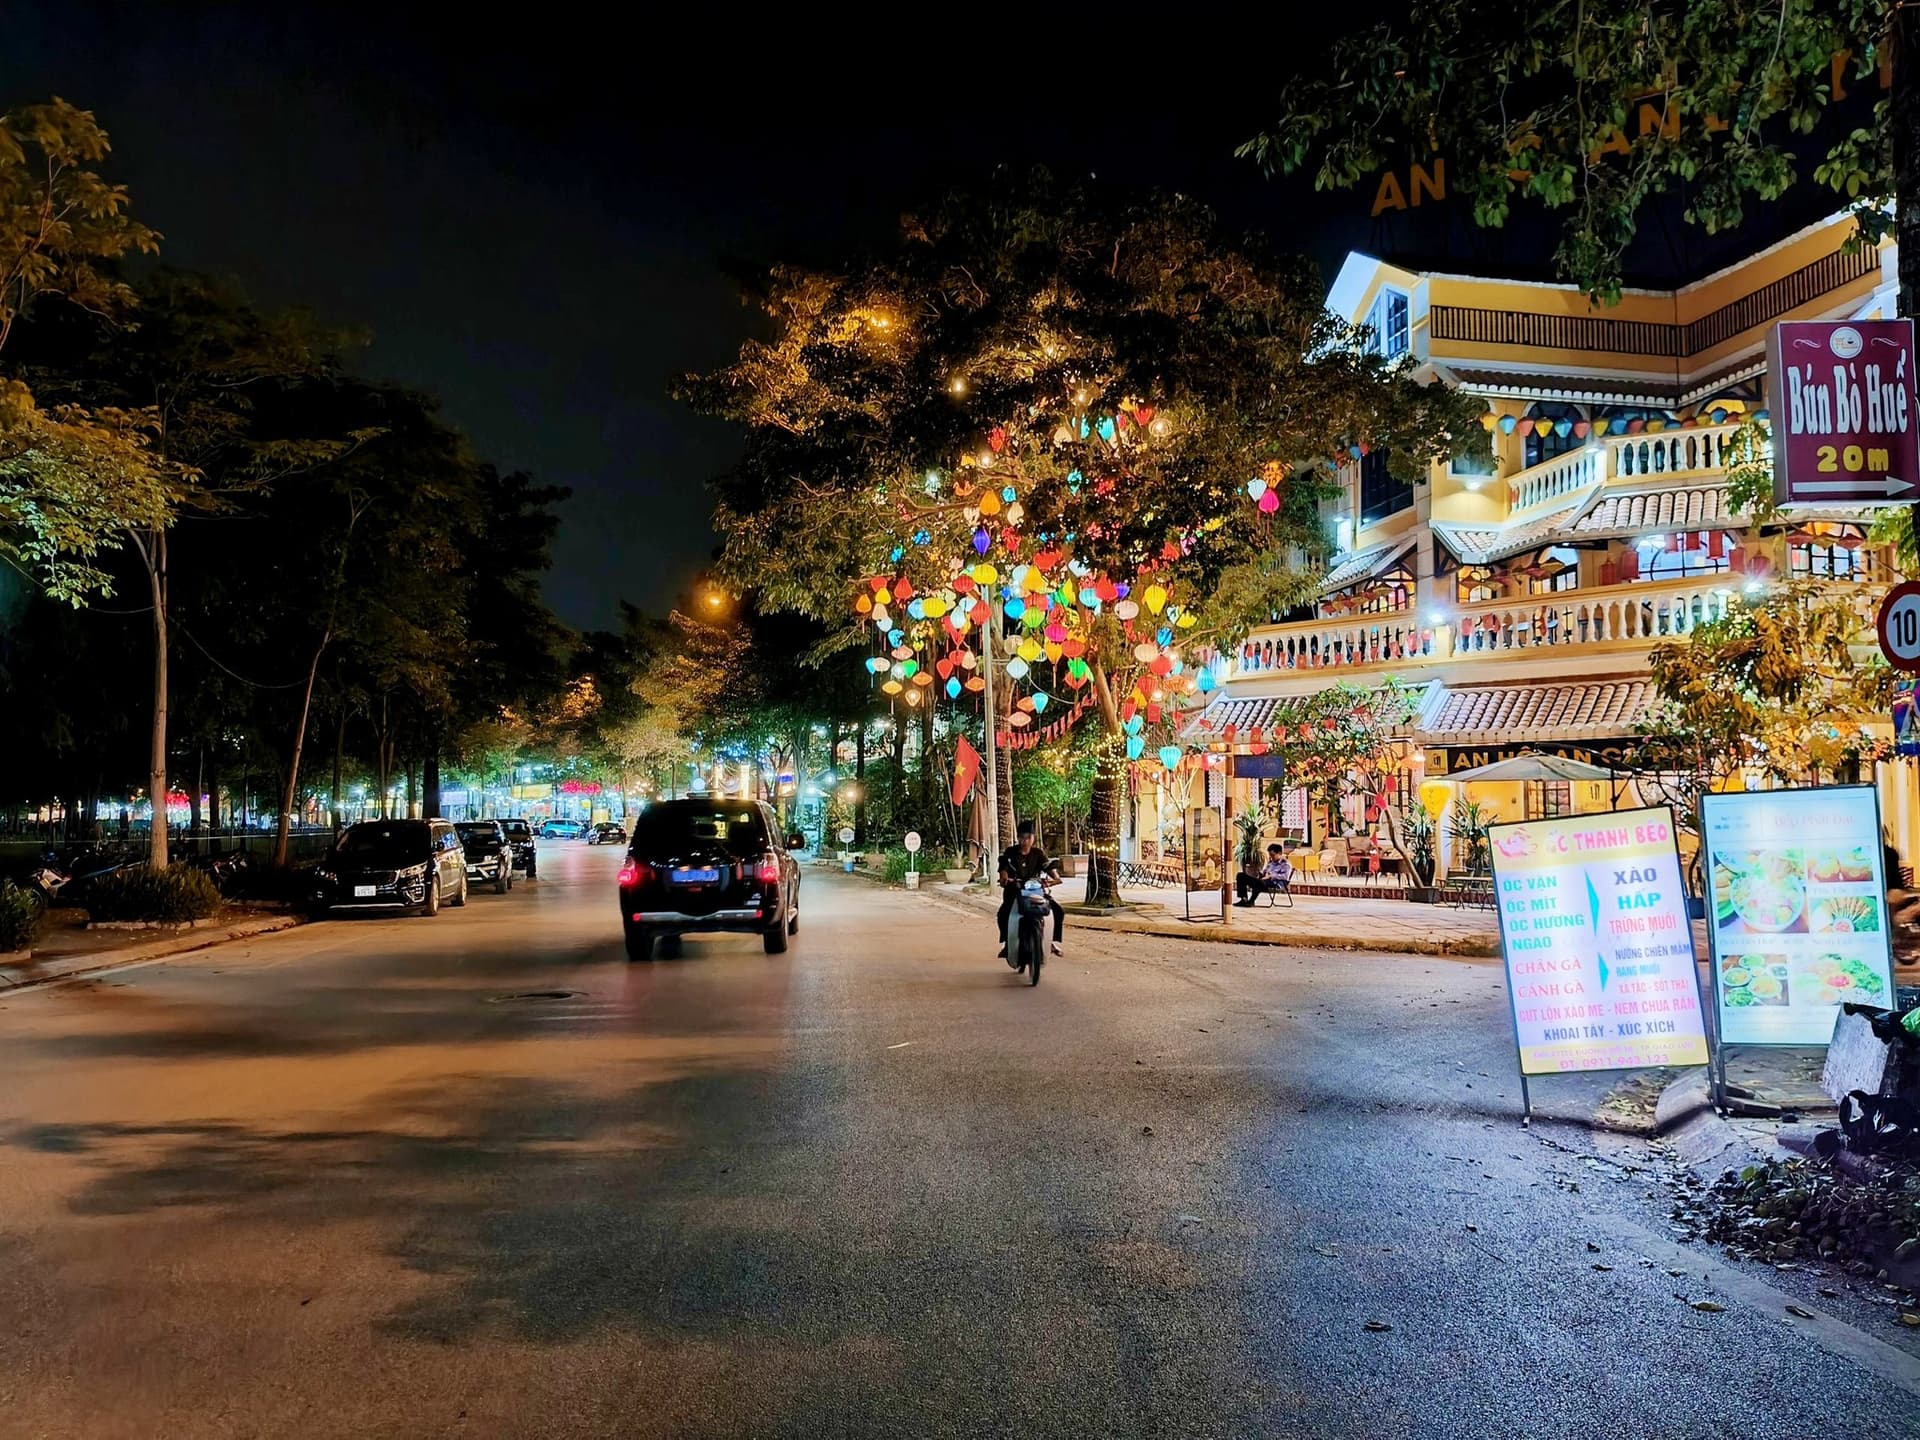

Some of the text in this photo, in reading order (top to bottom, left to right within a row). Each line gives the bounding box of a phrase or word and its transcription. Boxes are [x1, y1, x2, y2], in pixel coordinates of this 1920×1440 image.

[1370, 157, 1447, 218] AN
[1787, 348, 1908, 434] Bún Bò Huế
[1816, 445, 1889, 472] 20m
[1892, 608, 1917, 647] 10
[1454, 752, 1489, 768] AN
[1572, 828, 1629, 850] THANH
[1512, 936, 1552, 951] NGAO
[1544, 1027, 1580, 1041] KHOAI
[1583, 1023, 1604, 1038] TÂY
